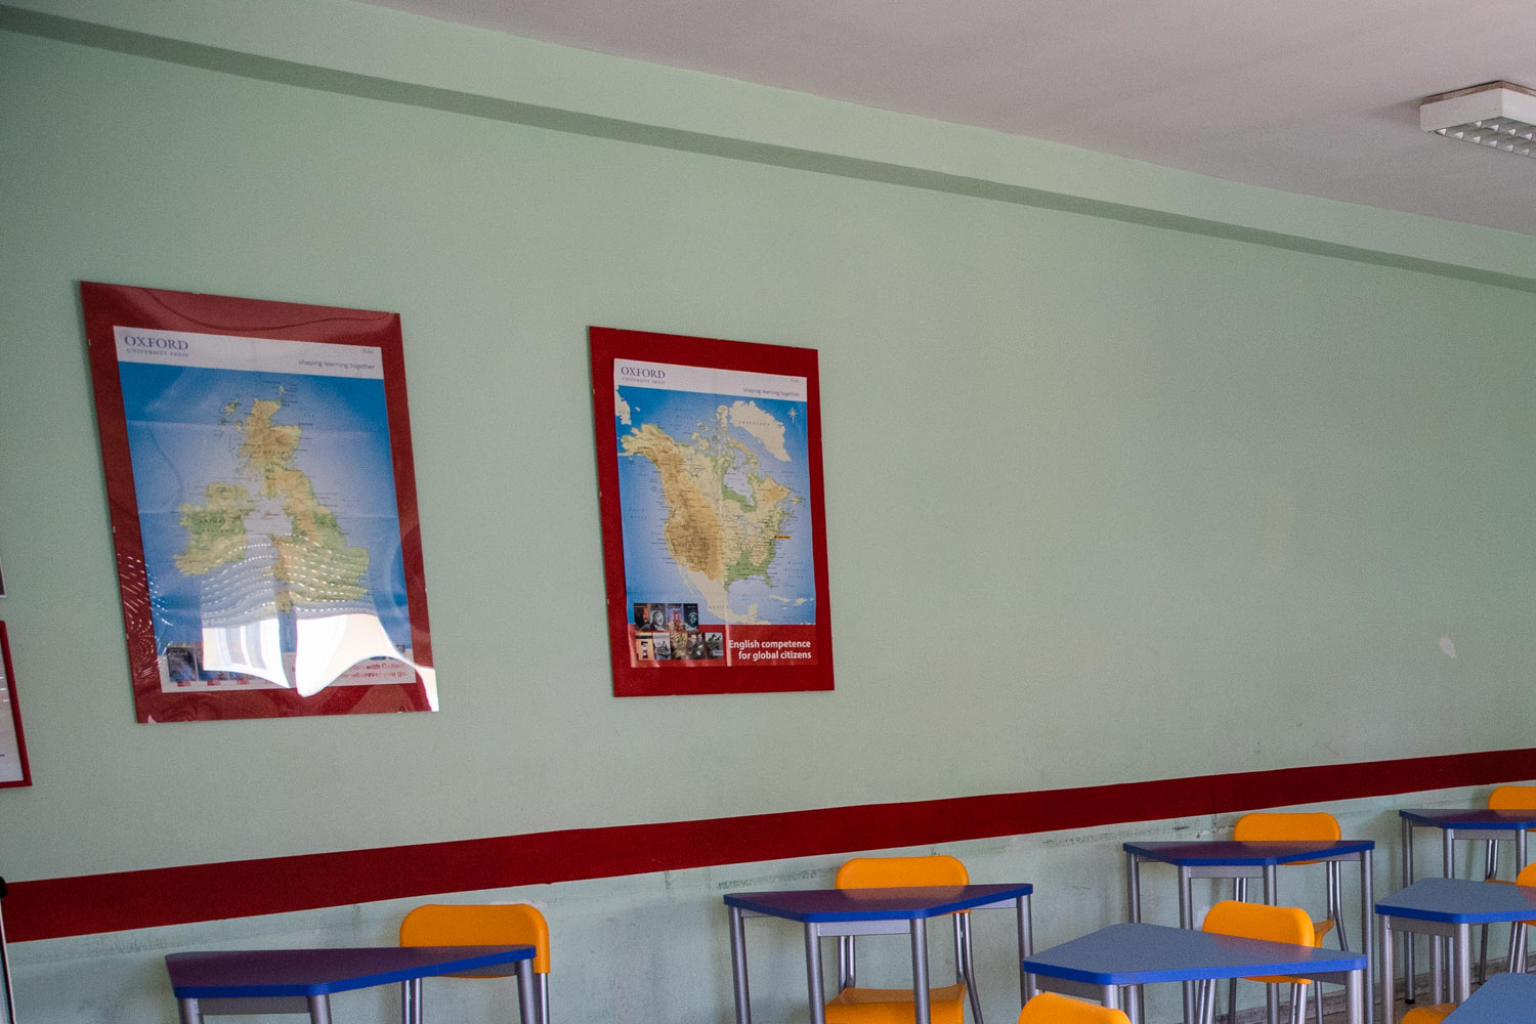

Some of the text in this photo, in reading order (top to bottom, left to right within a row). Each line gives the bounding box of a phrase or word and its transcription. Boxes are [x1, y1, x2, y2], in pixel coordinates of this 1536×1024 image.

[124, 336, 189, 350] OXFORD
[620, 366, 666, 379] OXFORD
[729, 640, 811, 650] English competence
[738, 650, 812, 662] for global citizens
